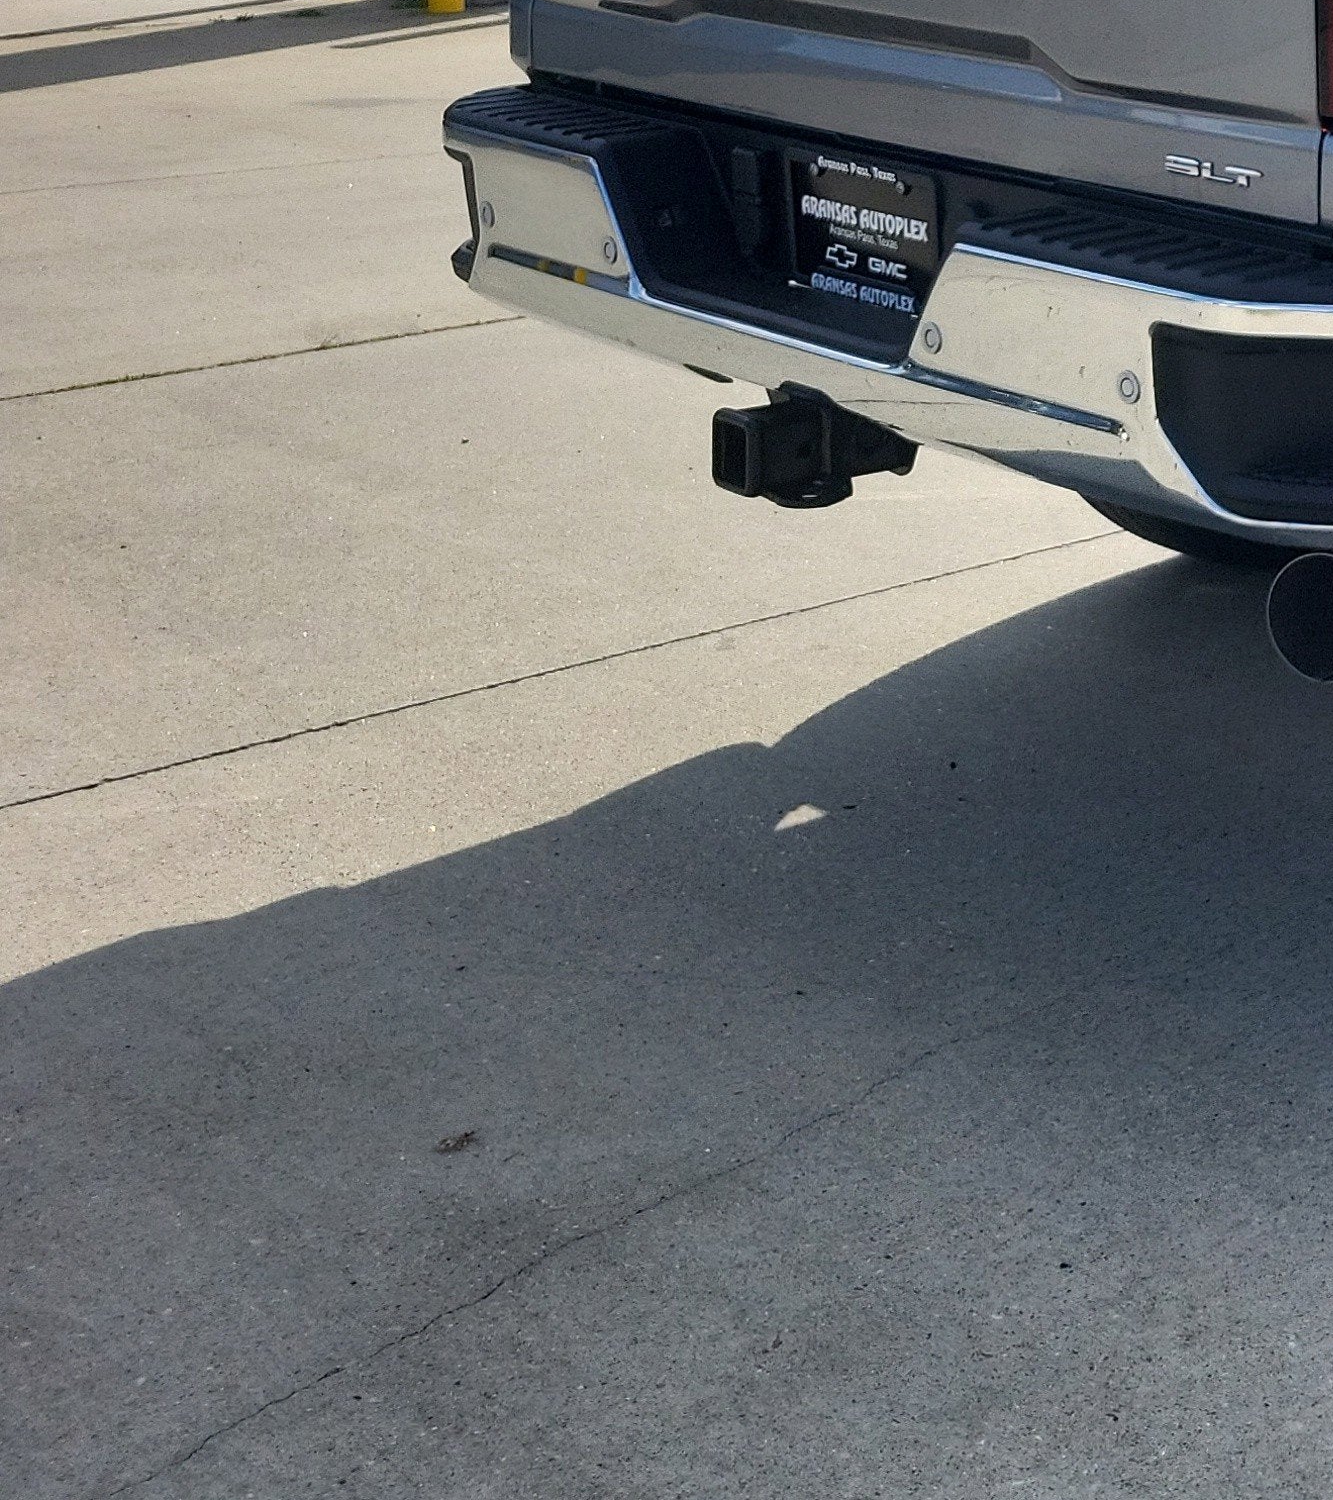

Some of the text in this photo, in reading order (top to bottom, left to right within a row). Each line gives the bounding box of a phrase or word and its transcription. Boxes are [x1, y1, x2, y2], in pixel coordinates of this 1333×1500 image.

[817, 155, 849, 173] Aransas
[872, 166, 897, 183] Texas
[1164, 154, 1264, 187] SLT
[801, 194, 929, 242] ARANSAS AUTOPLEX
[868, 256, 908, 280] GMC
[811, 272, 917, 313] ARANSAS AUTOPLEX
